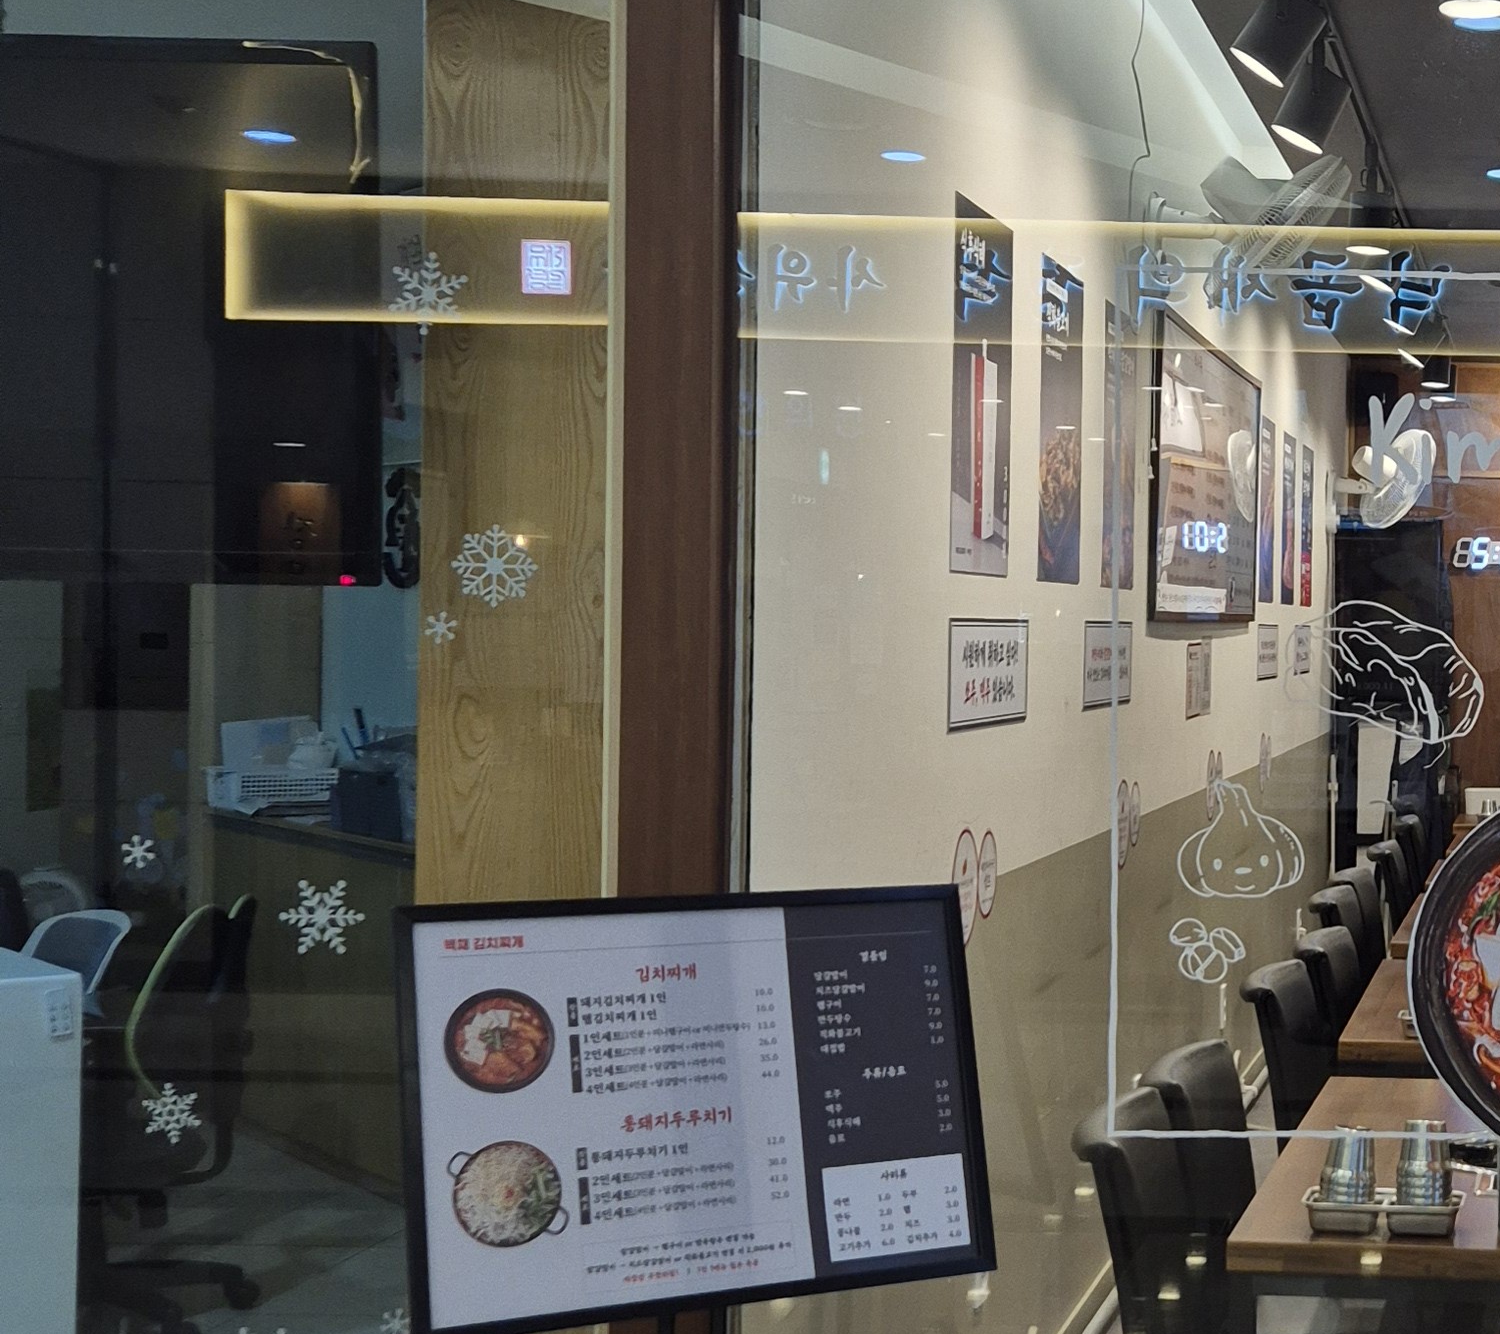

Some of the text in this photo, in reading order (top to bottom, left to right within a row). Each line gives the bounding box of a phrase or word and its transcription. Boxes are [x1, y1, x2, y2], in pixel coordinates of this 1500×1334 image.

[443, 935, 524, 951] 백채 김치찌개
[636, 962, 697, 983] 김치찌개
[580, 993, 646, 1007] 돼지김치찌개
[650, 991, 667, 1004] 1인
[640, 1009, 657, 1021] 1인
[621, 1106, 733, 1133] 통돼지두루치기
[671, 1142, 689, 1155] 1인
